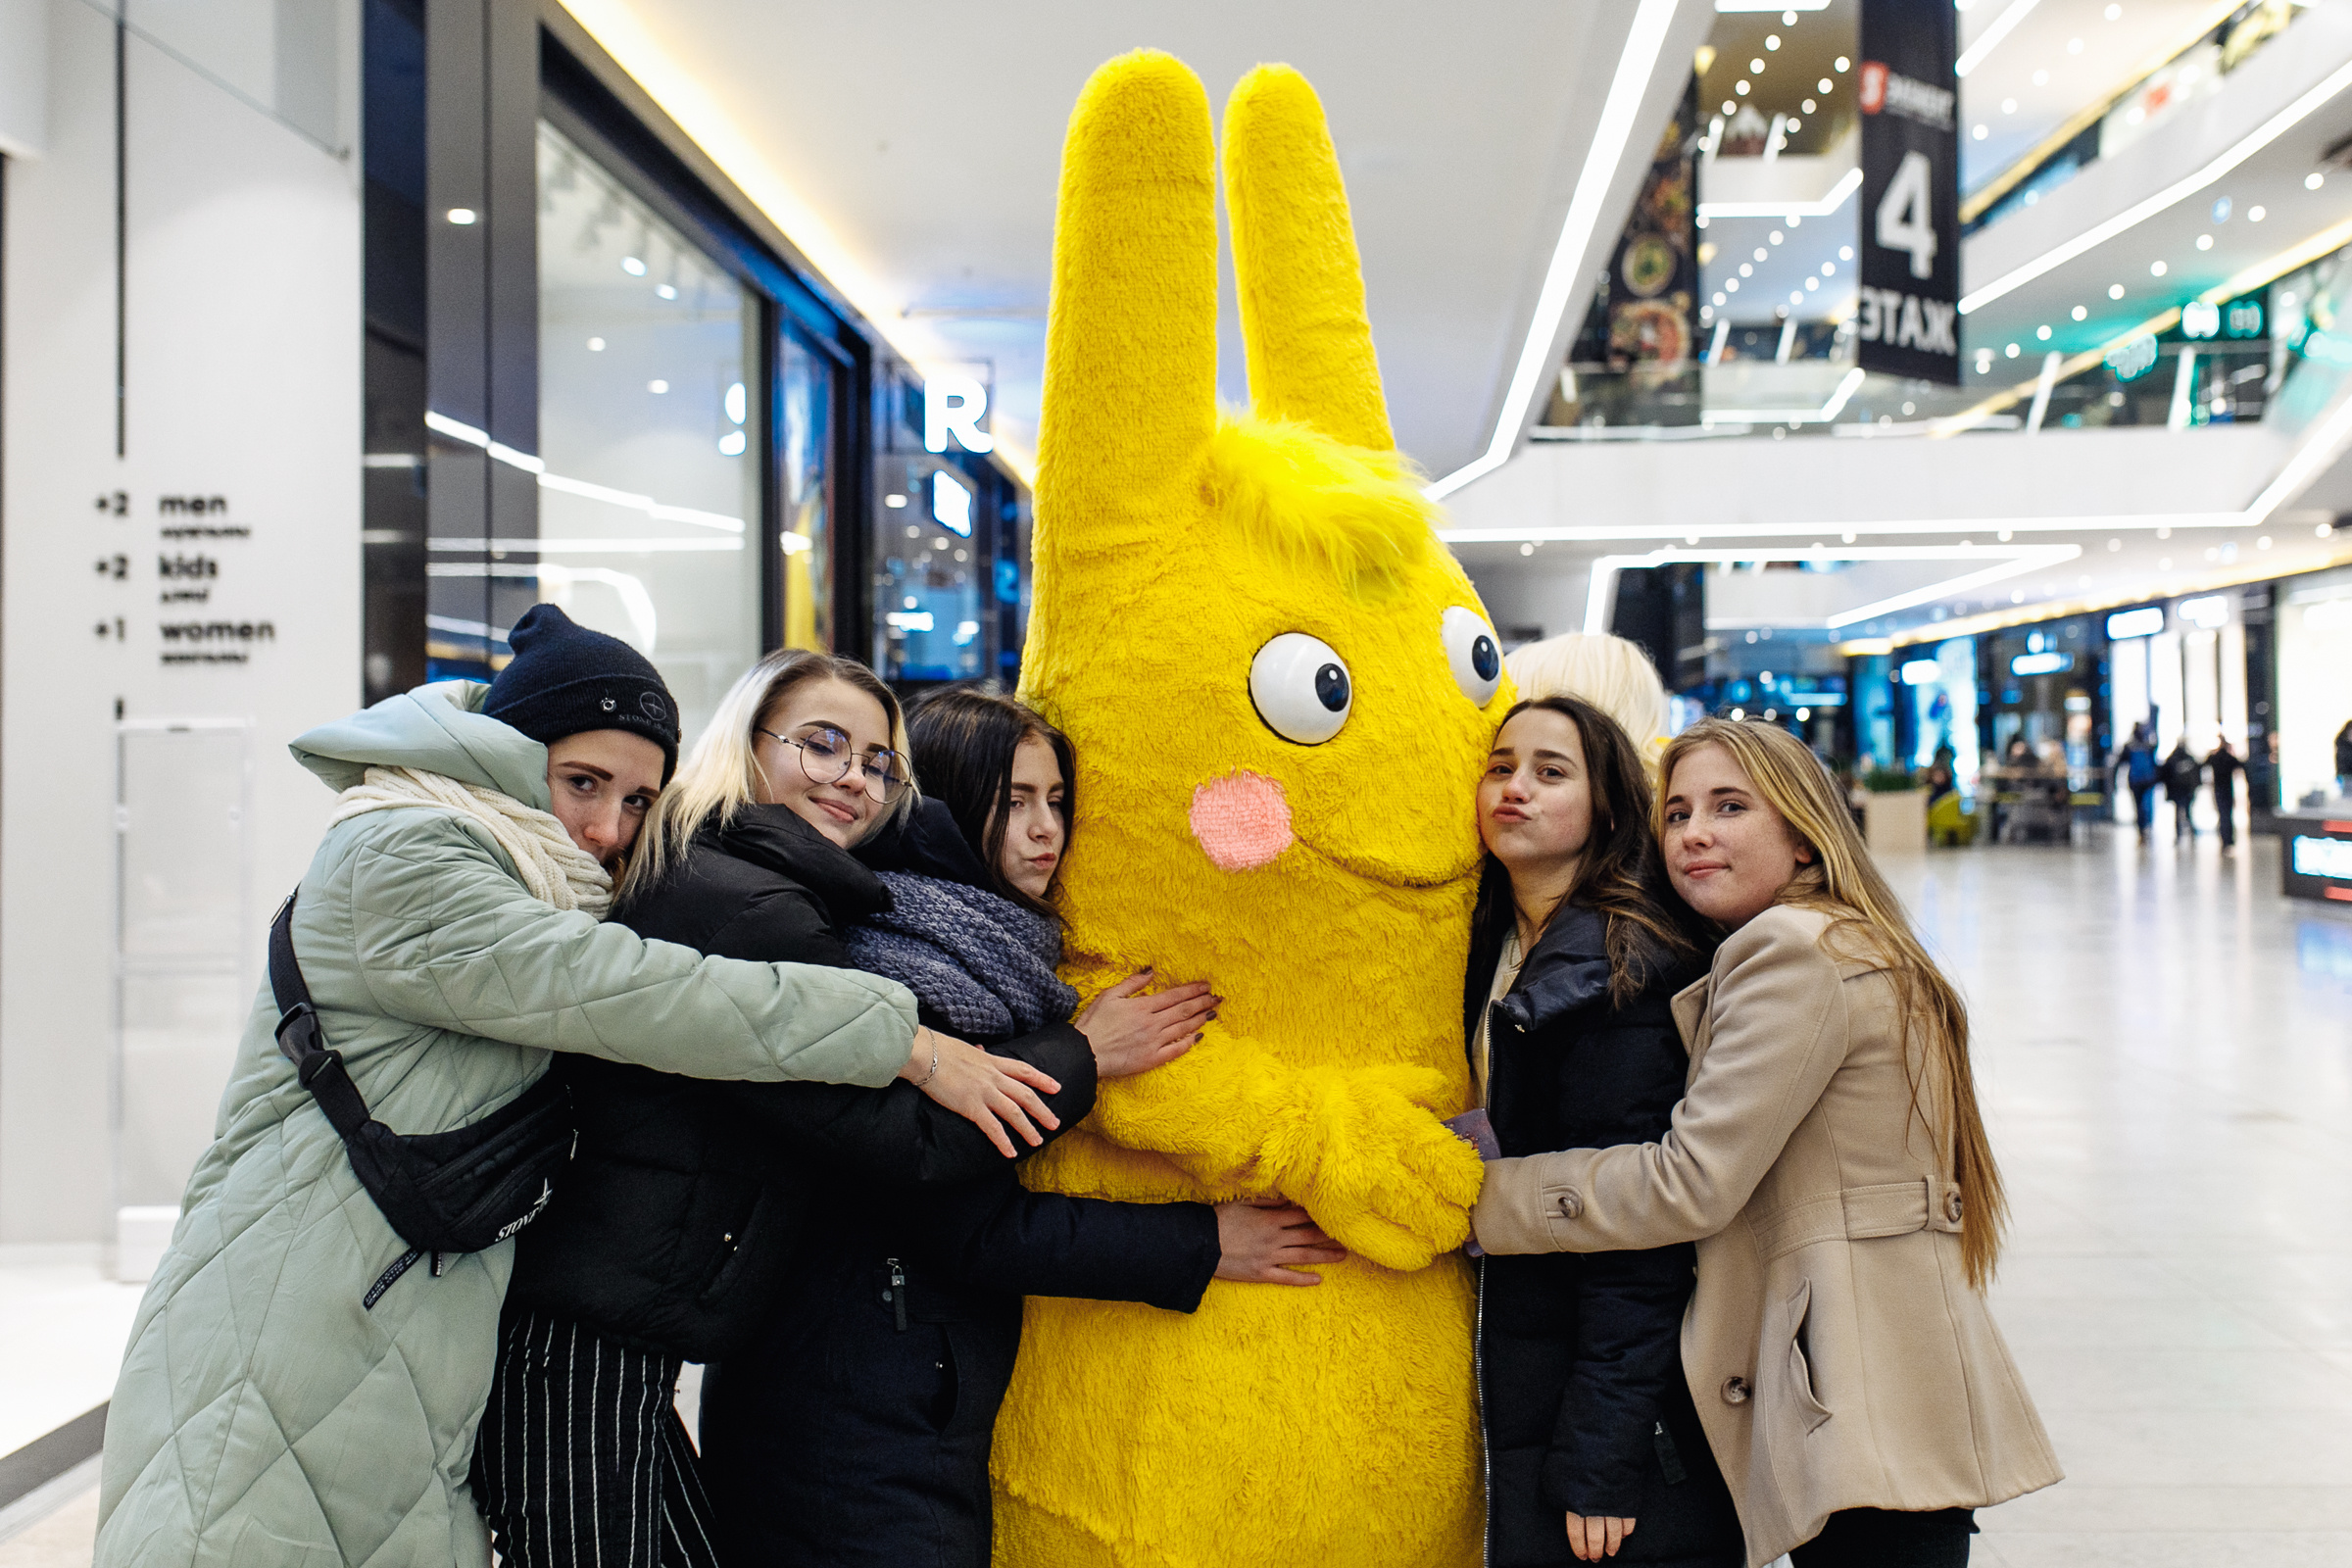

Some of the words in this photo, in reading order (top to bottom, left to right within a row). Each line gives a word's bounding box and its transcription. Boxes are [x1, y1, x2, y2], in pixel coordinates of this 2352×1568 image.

[1876, 150, 1938, 280] 4
[1860, 285, 1958, 357] ЭТАЖ
[924, 374, 994, 455] R
[158, 495, 226, 515] men
[158, 553, 218, 578] kids
[159, 620, 274, 641] women
